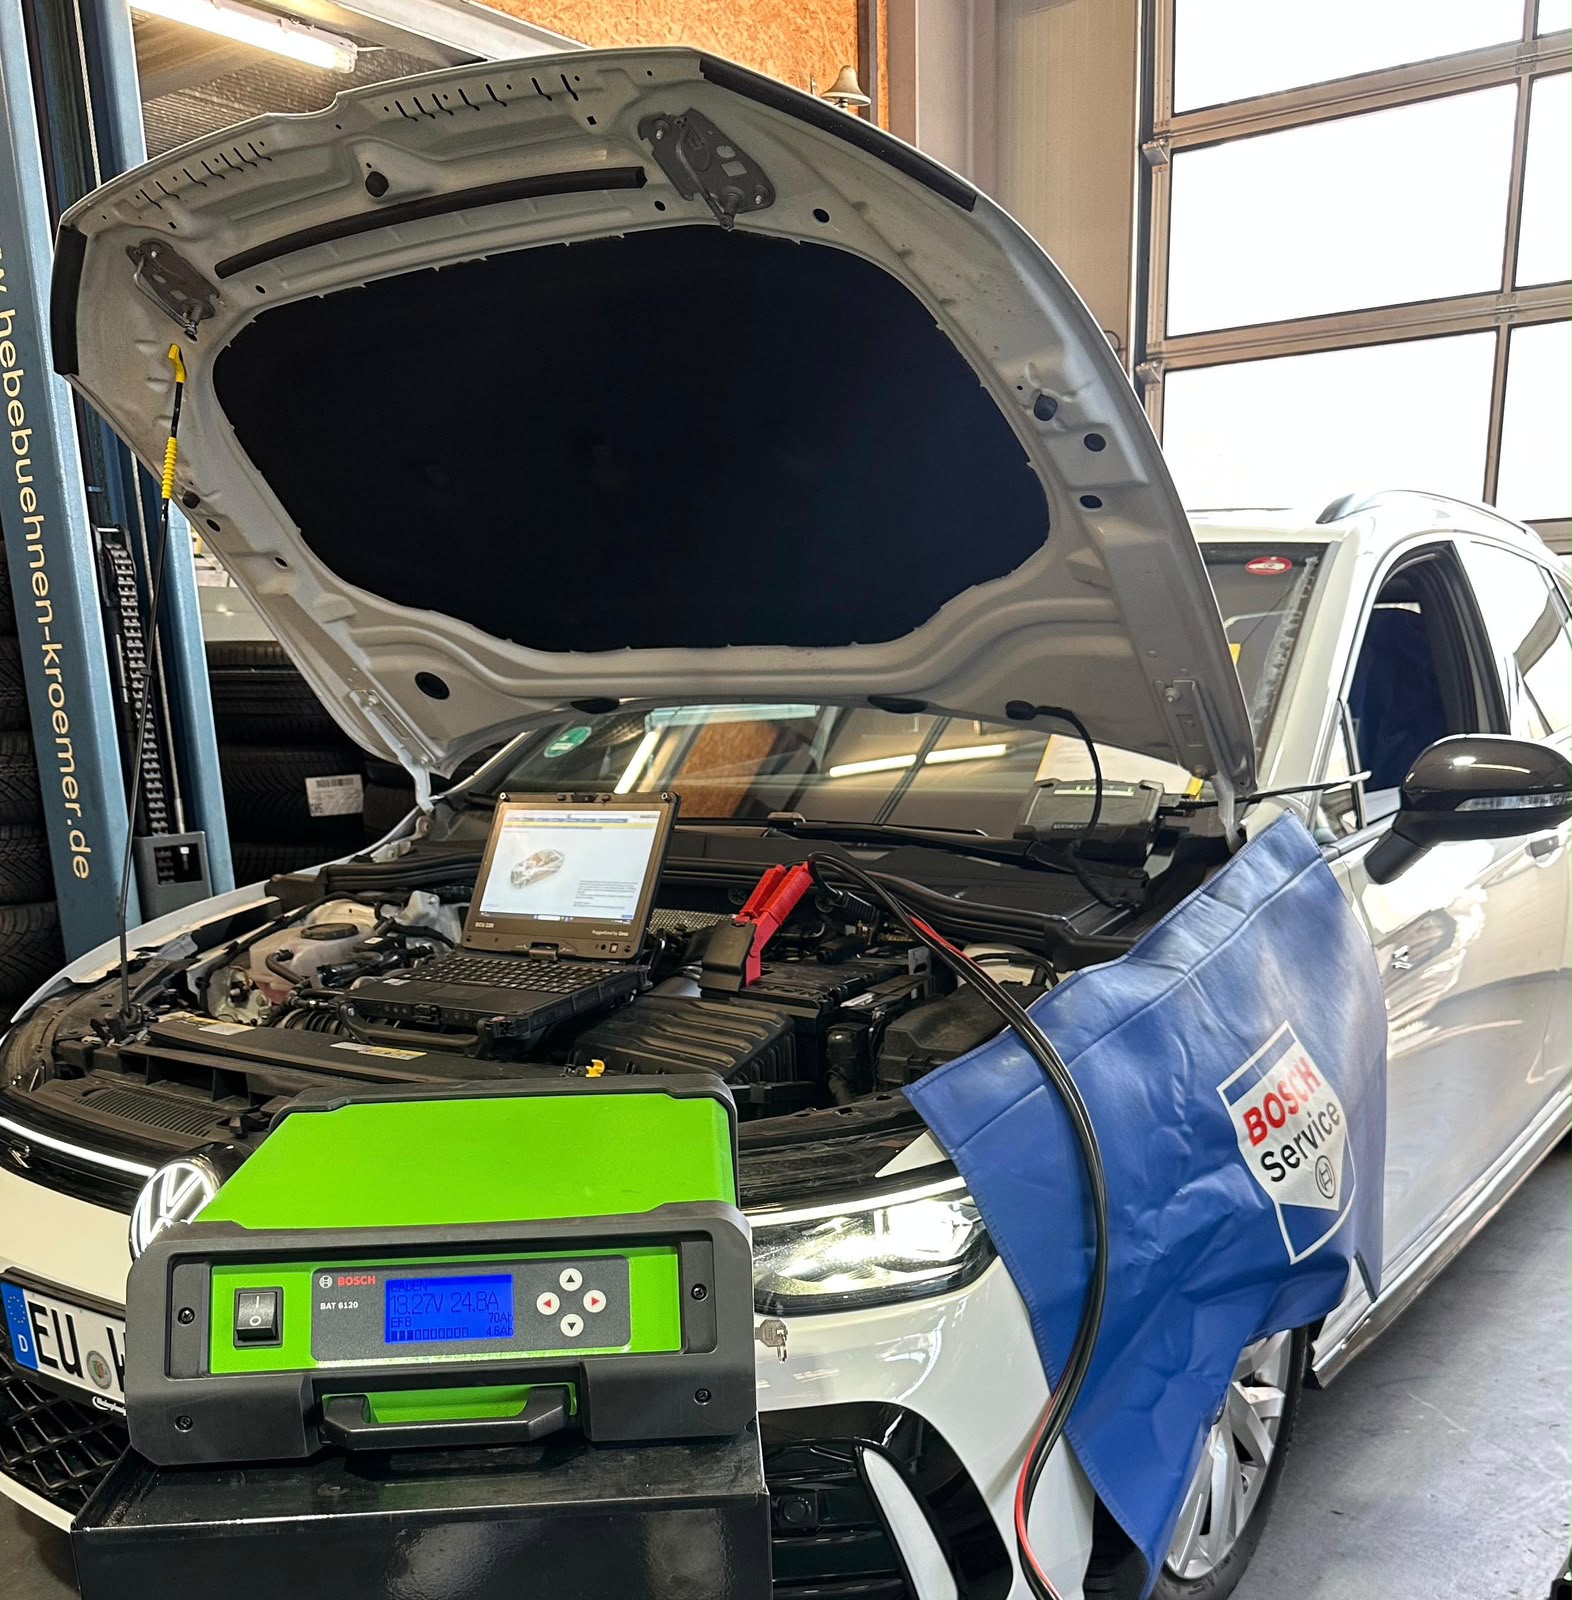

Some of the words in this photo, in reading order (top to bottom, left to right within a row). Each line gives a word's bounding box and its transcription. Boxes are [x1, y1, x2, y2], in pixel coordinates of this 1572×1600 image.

[0, 247, 91, 879] hebebuehnen-kroemer.de
[1242, 1057, 1321, 1147] BOSCH
[1260, 1101, 1340, 1183] Service
[337, 1275, 376, 1286] BOSCH
[320, 1302, 336, 1310] BAT
[338, 1301, 359, 1309] 6120
[450, 1290, 500, 1313] 24.8A
[391, 1316, 412, 1328] EFB
[17, 1333, 29, 1353] D
[27, 1300, 84, 1379] EU
